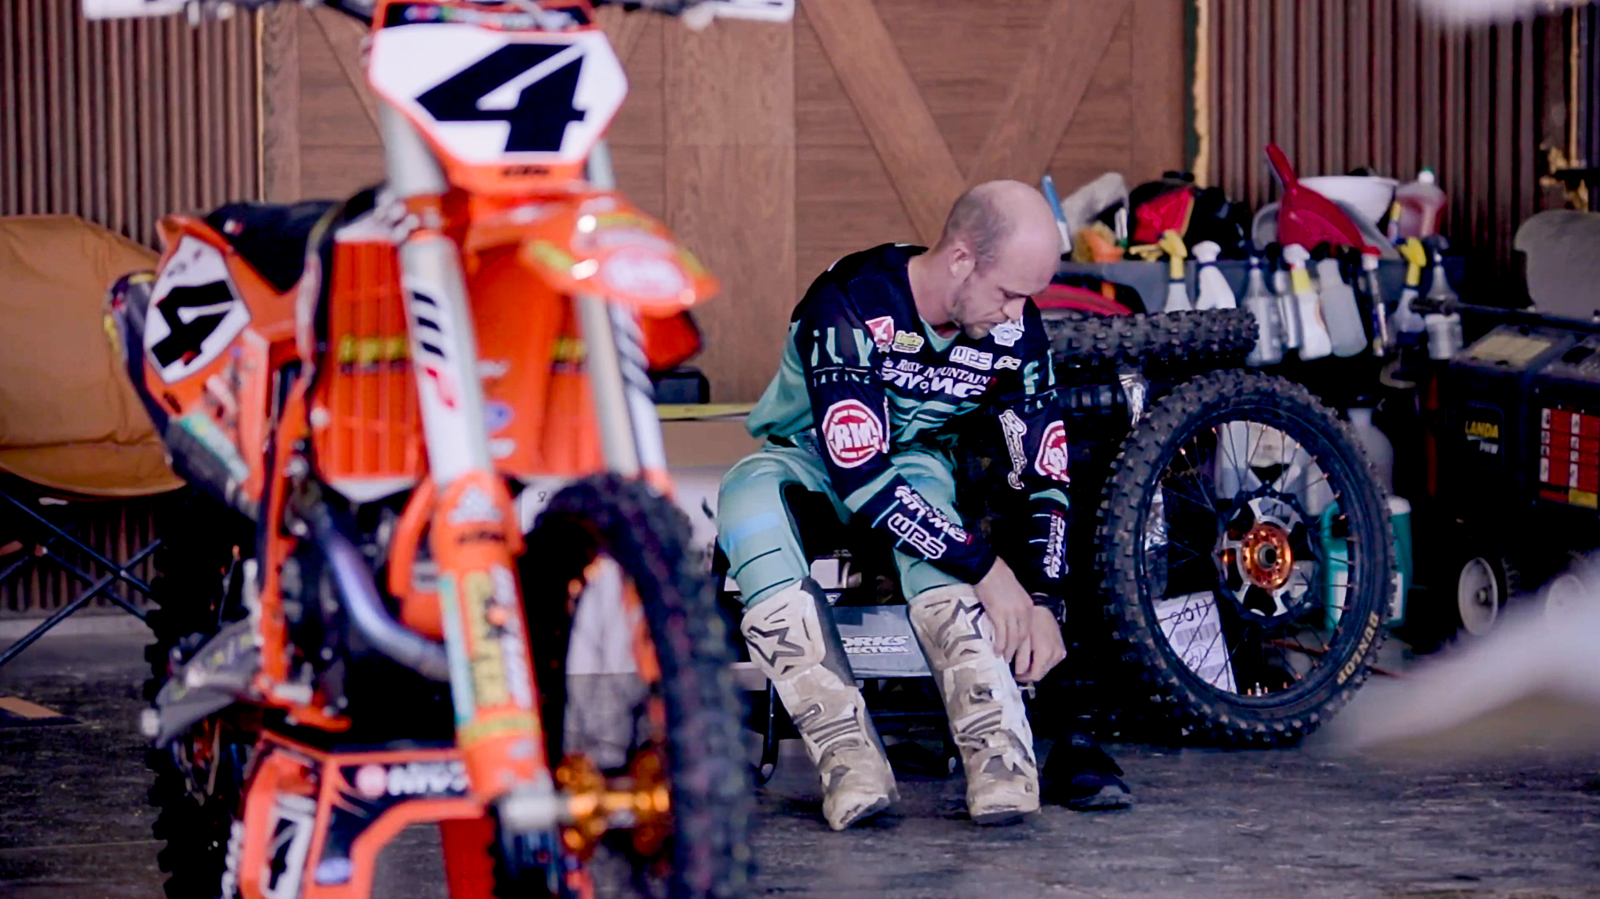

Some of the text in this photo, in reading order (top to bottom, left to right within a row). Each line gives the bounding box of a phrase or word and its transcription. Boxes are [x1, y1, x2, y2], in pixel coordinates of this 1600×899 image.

[415, 43, 587, 152] 4
[151, 280, 234, 369] 4
[949, 346, 994, 371] WPS
[1465, 420, 1499, 439] LANDA
[889, 513, 948, 560] WPS
[1336, 610, 1380, 686] DUNLOP
